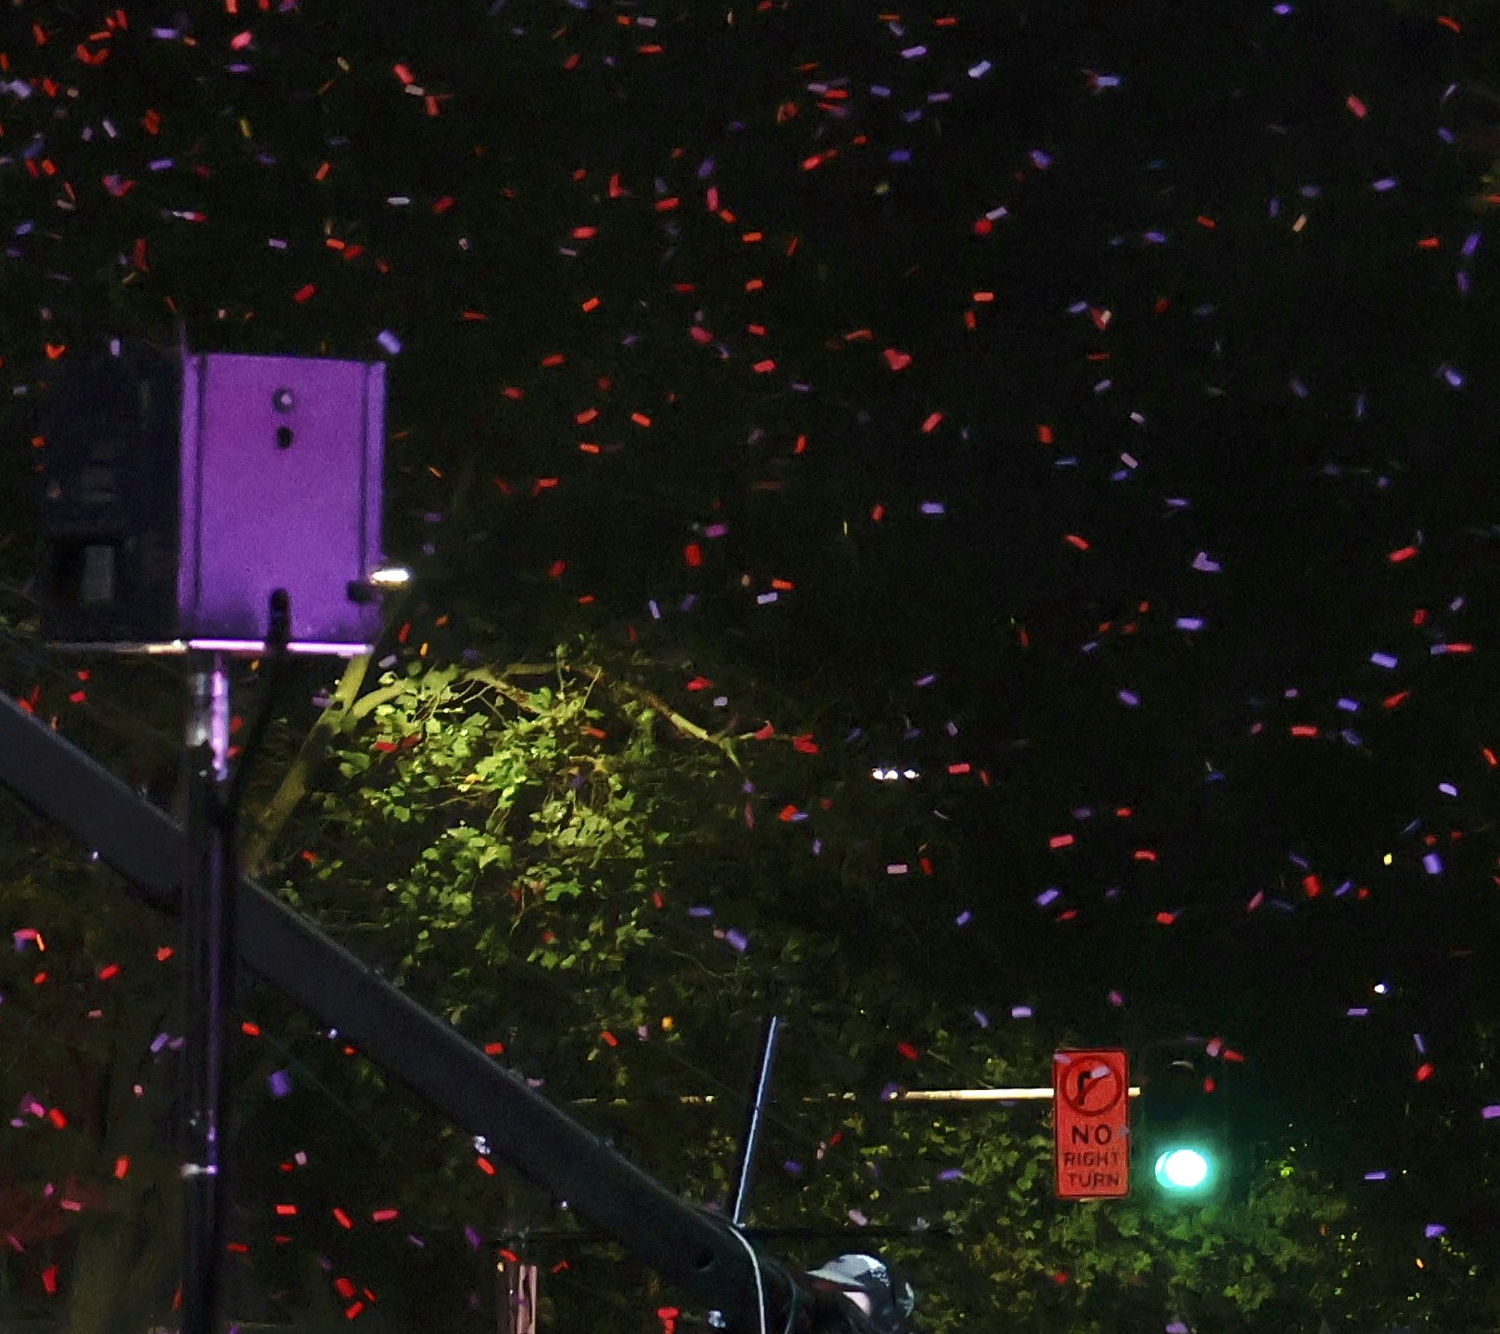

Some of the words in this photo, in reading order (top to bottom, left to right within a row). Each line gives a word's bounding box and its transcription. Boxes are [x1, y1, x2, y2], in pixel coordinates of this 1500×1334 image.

[1071, 1124, 1112, 1145] NO
[1063, 1151, 1120, 1167] RIGHT
[1067, 1172, 1120, 1188] TURN
